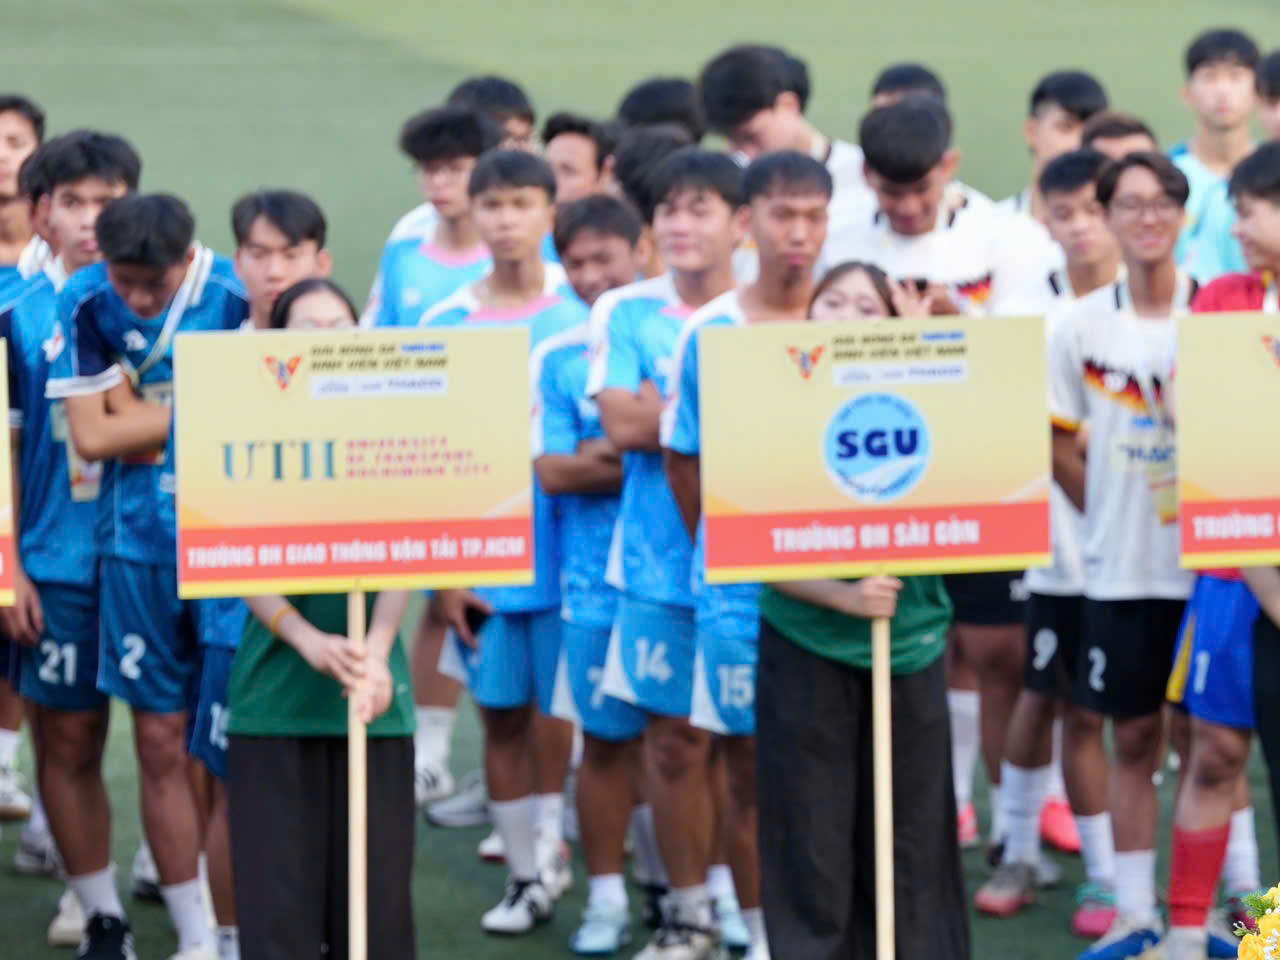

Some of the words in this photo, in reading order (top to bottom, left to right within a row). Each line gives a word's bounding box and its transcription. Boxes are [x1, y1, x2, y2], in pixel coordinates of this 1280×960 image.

[221, 438, 336, 482] UTH
[837, 428, 919, 460] SGU
[38, 639, 78, 686] 21
[119, 632, 147, 680] 2
[635, 636, 674, 683] 14
[1032, 628, 1058, 671] 9
[1087, 646, 1108, 692] 2
[717, 663, 756, 708] 15
